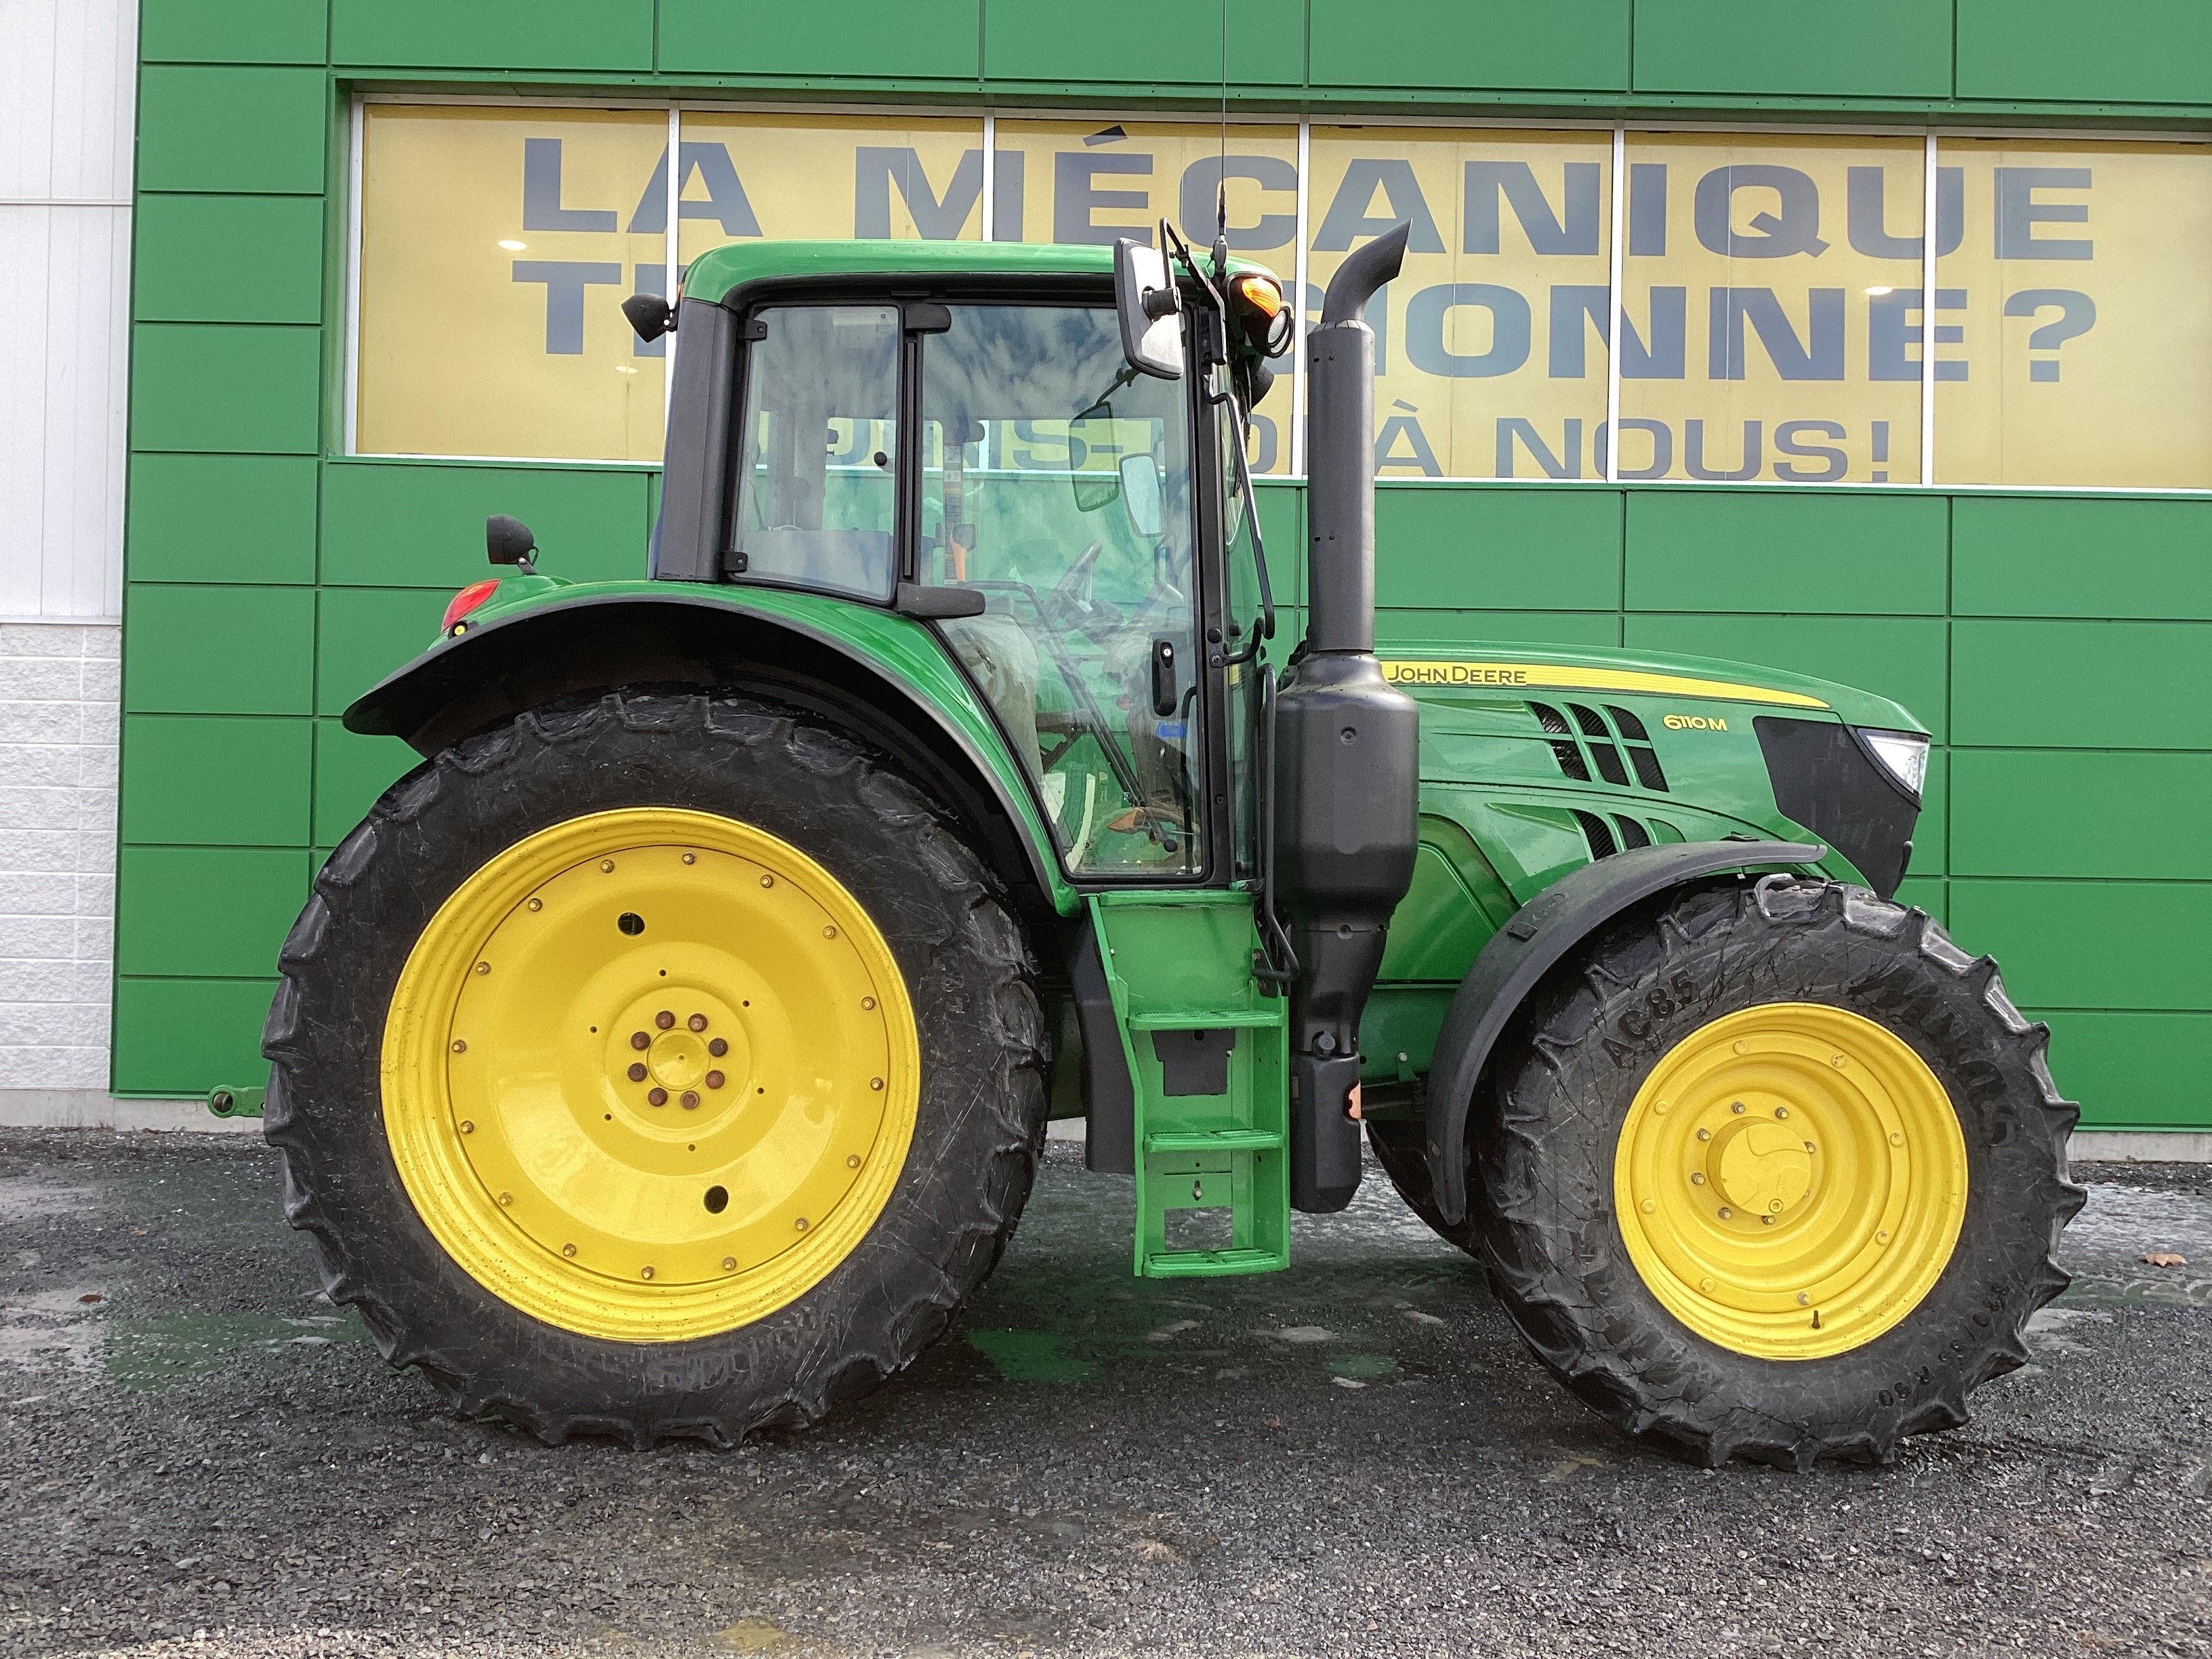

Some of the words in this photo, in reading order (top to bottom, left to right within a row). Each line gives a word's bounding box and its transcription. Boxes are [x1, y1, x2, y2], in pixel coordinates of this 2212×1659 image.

[522, 137, 764, 237] LA
[853, 125, 2093, 261] MÉCANIQUE
[512, 260, 690, 357] T
[1495, 417, 1889, 483] NOUS!
[1388, 665, 1447, 682] JOHN
[1452, 665, 1527, 684] DEERE
